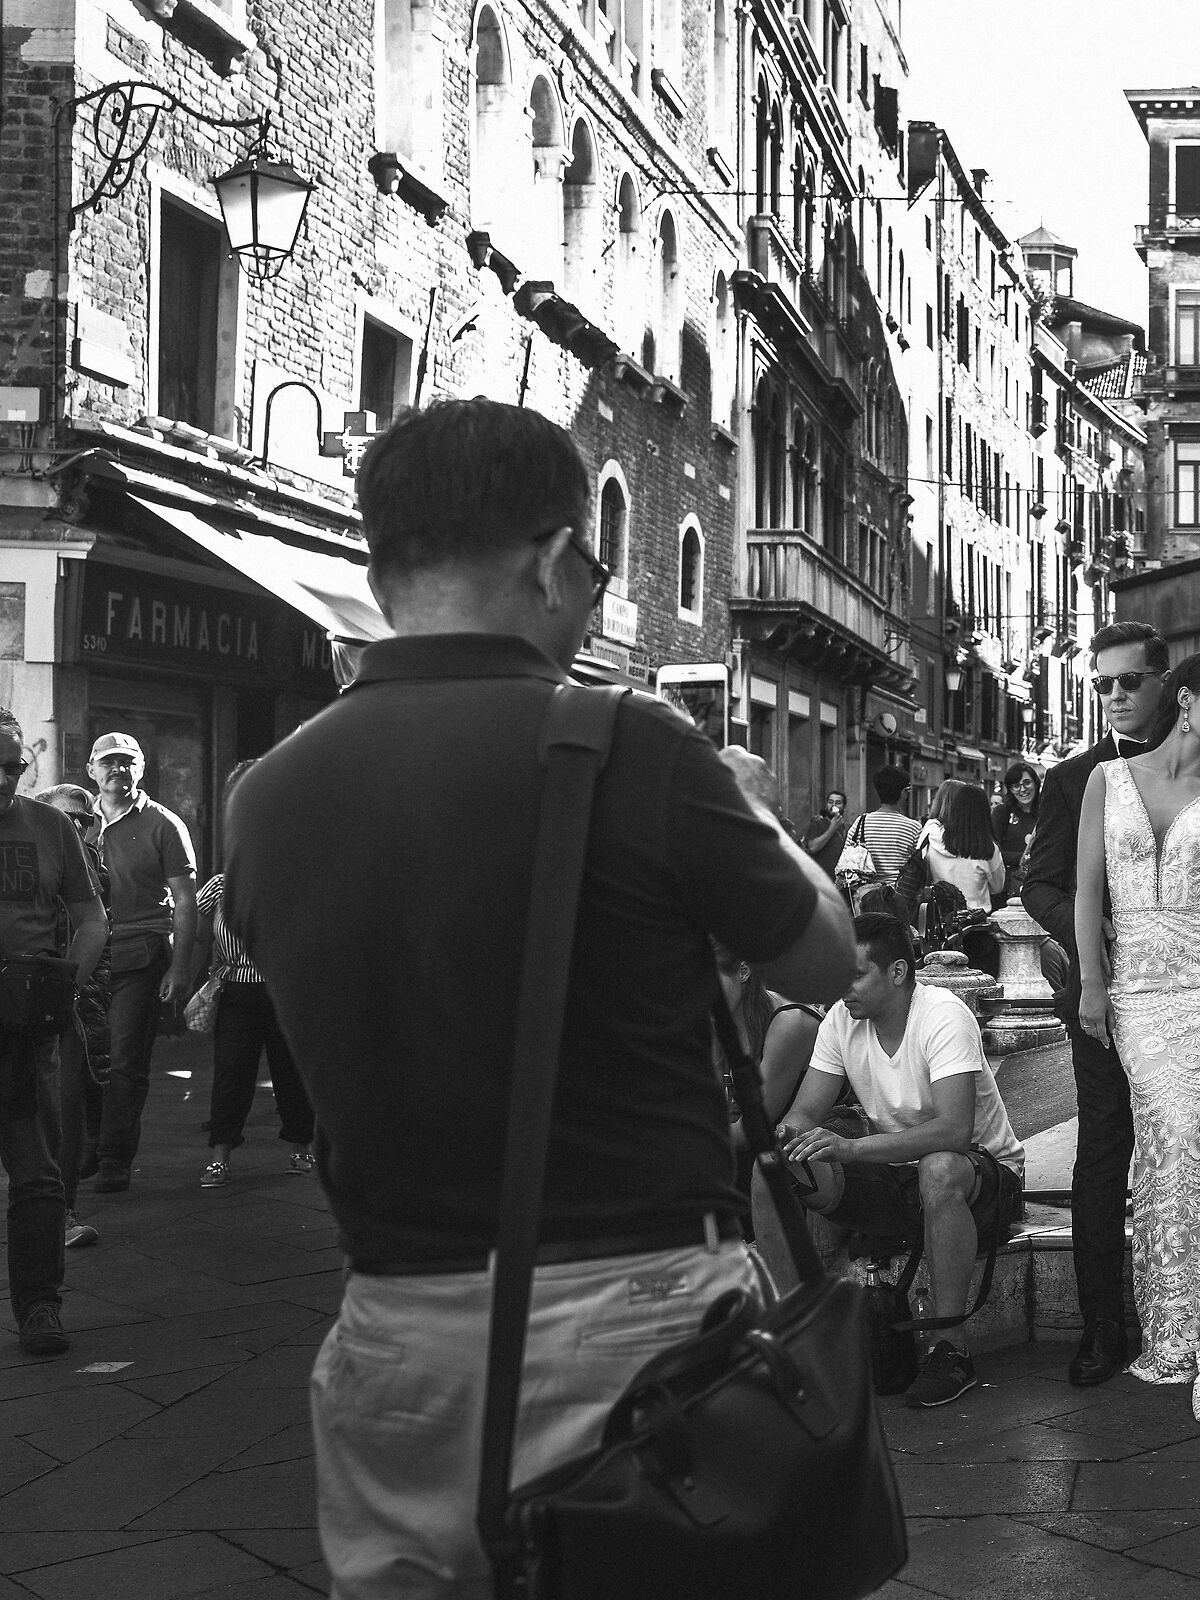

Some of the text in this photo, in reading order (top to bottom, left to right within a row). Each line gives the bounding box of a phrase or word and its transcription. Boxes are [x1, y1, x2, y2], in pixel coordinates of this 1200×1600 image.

[107, 591, 258, 660] FARMACIA
[0, 846, 33, 868] TE
[0, 870, 35, 892] ND
